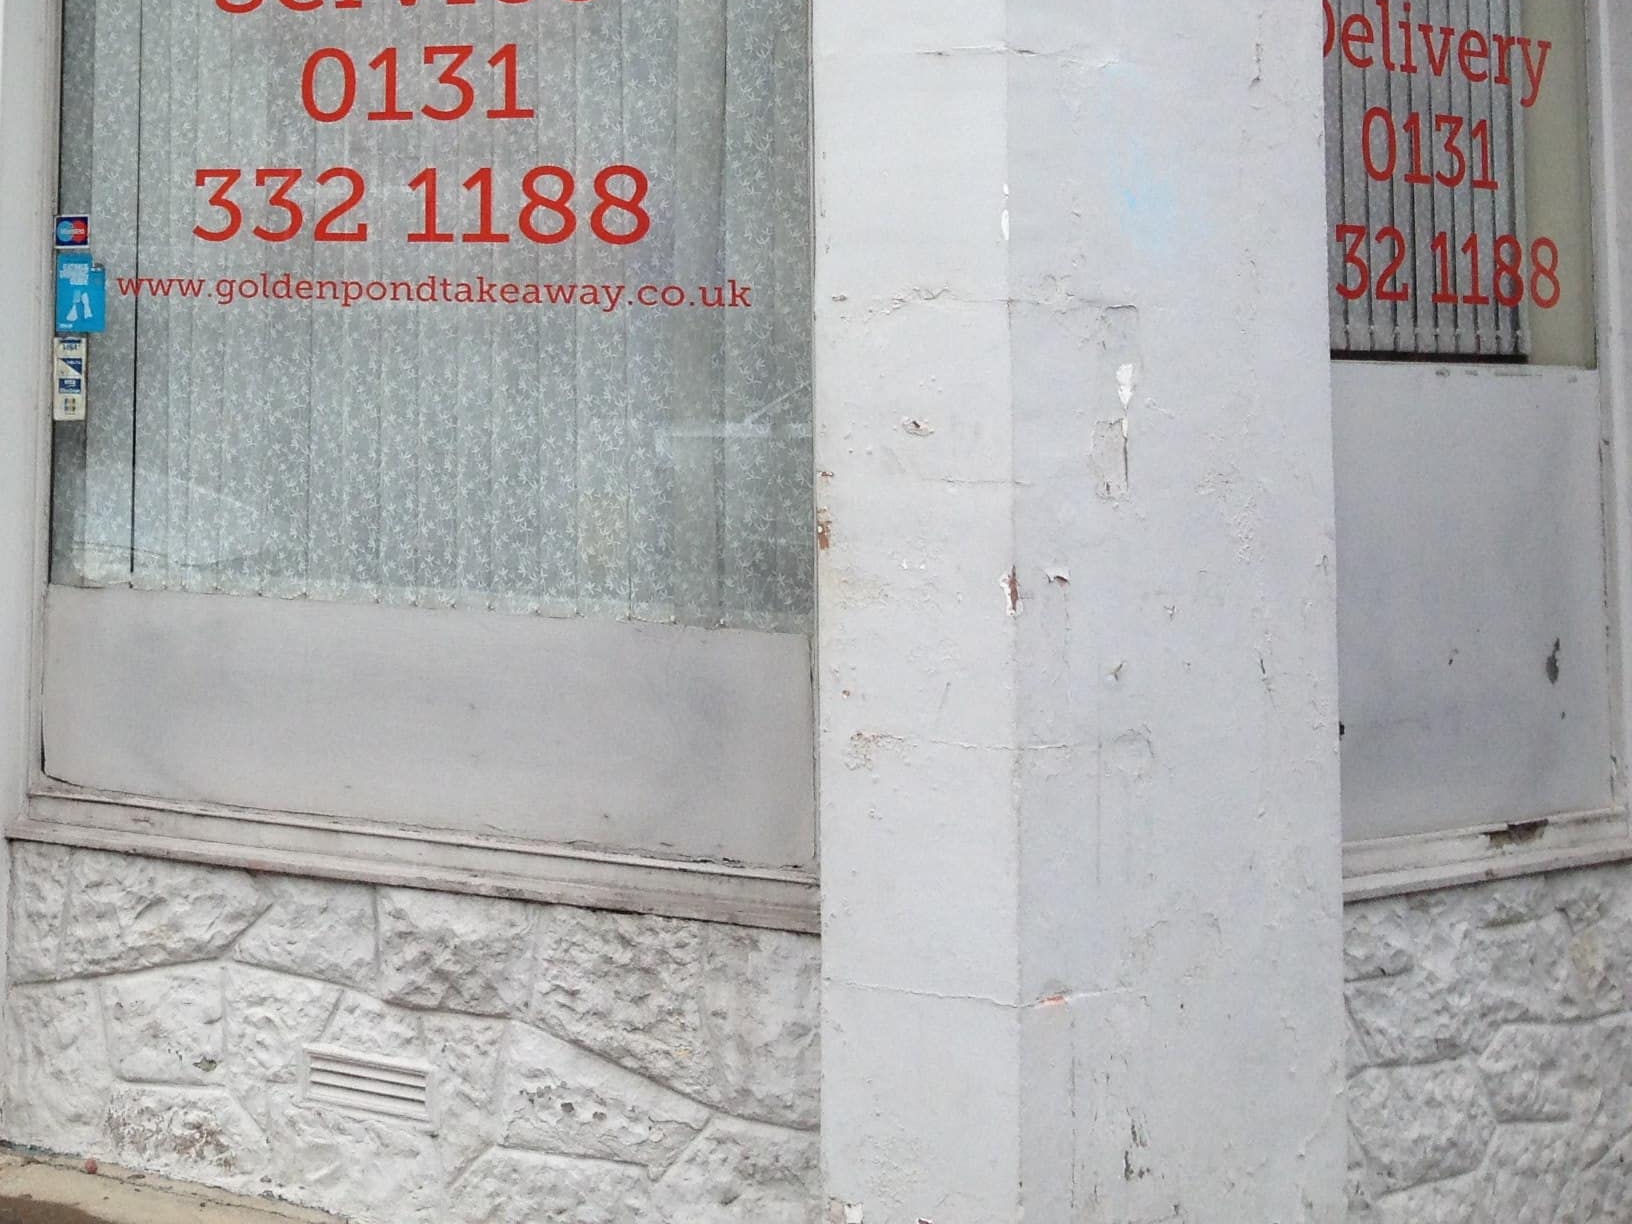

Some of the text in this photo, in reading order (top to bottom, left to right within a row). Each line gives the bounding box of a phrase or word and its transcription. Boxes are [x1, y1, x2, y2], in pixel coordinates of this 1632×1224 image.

[301, 43, 534, 123] 0131
[1362, 106, 1499, 191] 0131
[192, 165, 652, 245] 332 1188
[117, 272, 752, 311] www.goldenpondtakeaway.co.uk
[1430, 231, 1561, 308] 1188
